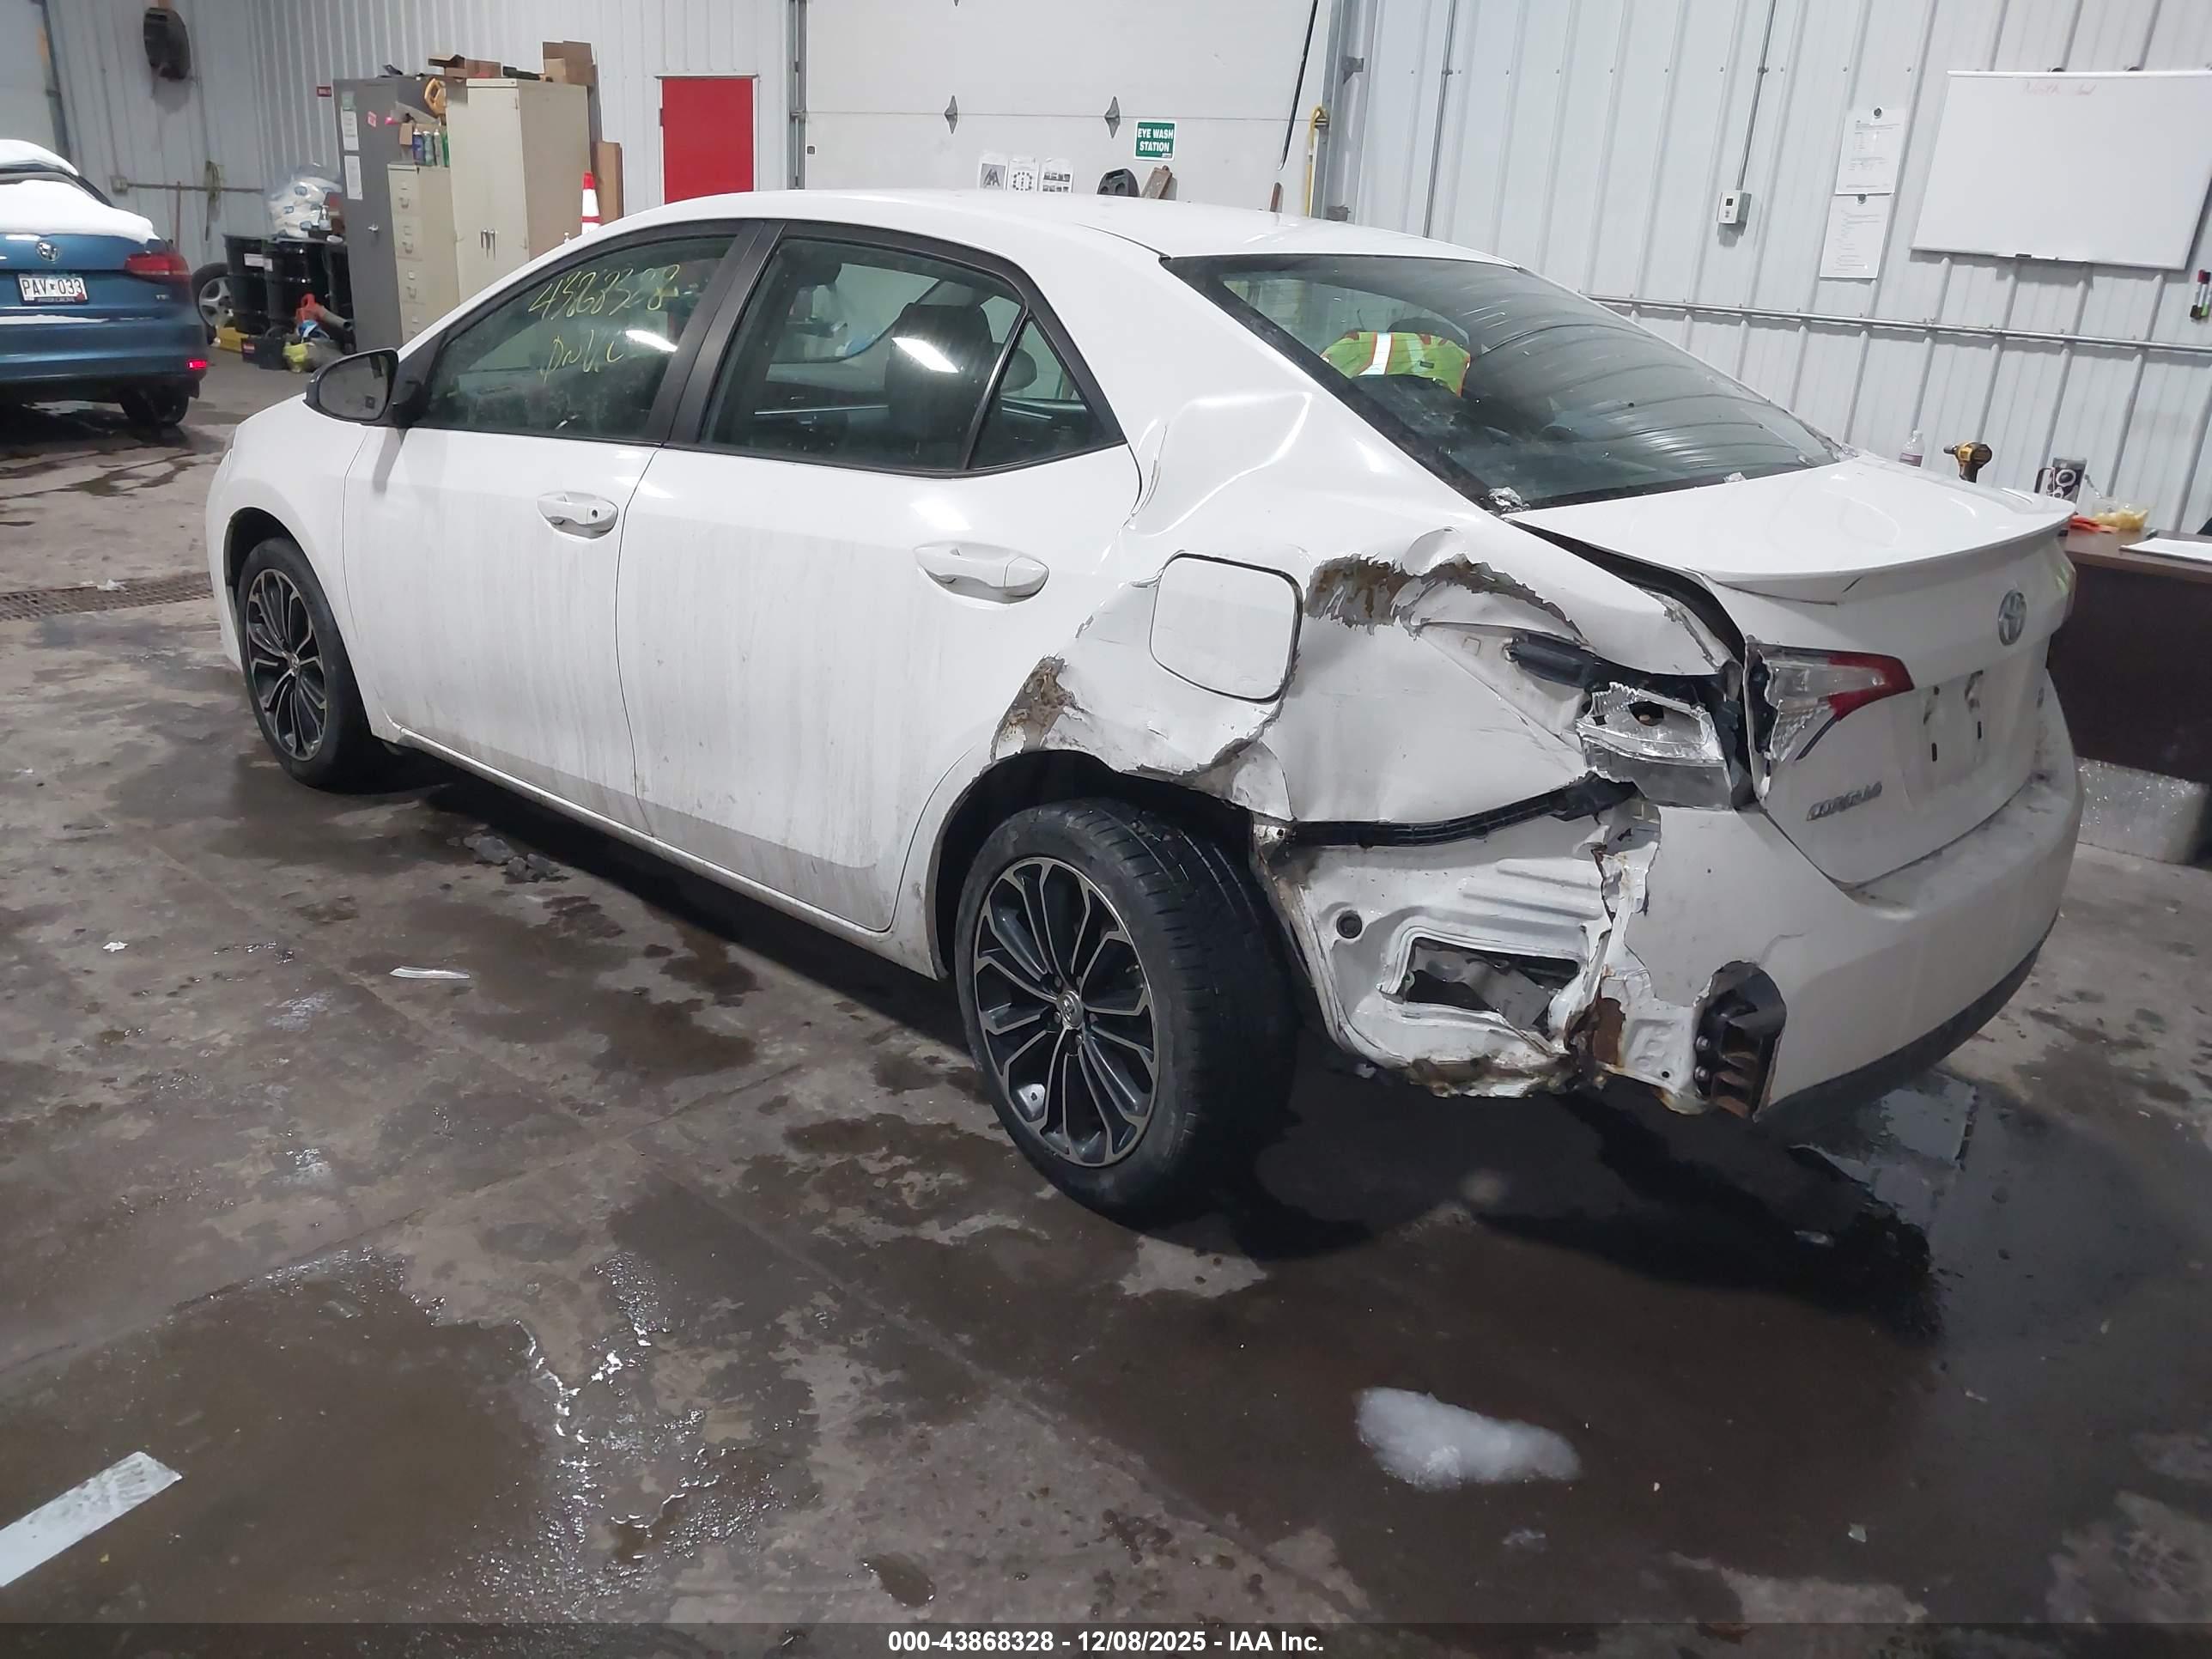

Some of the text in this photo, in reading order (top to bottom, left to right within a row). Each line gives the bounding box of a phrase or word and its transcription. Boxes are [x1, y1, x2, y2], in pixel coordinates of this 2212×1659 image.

[1137, 128, 1174, 139] EYE WASH
[1139, 140, 1170, 152] STATION
[21, 279, 83, 295] PAV 033
